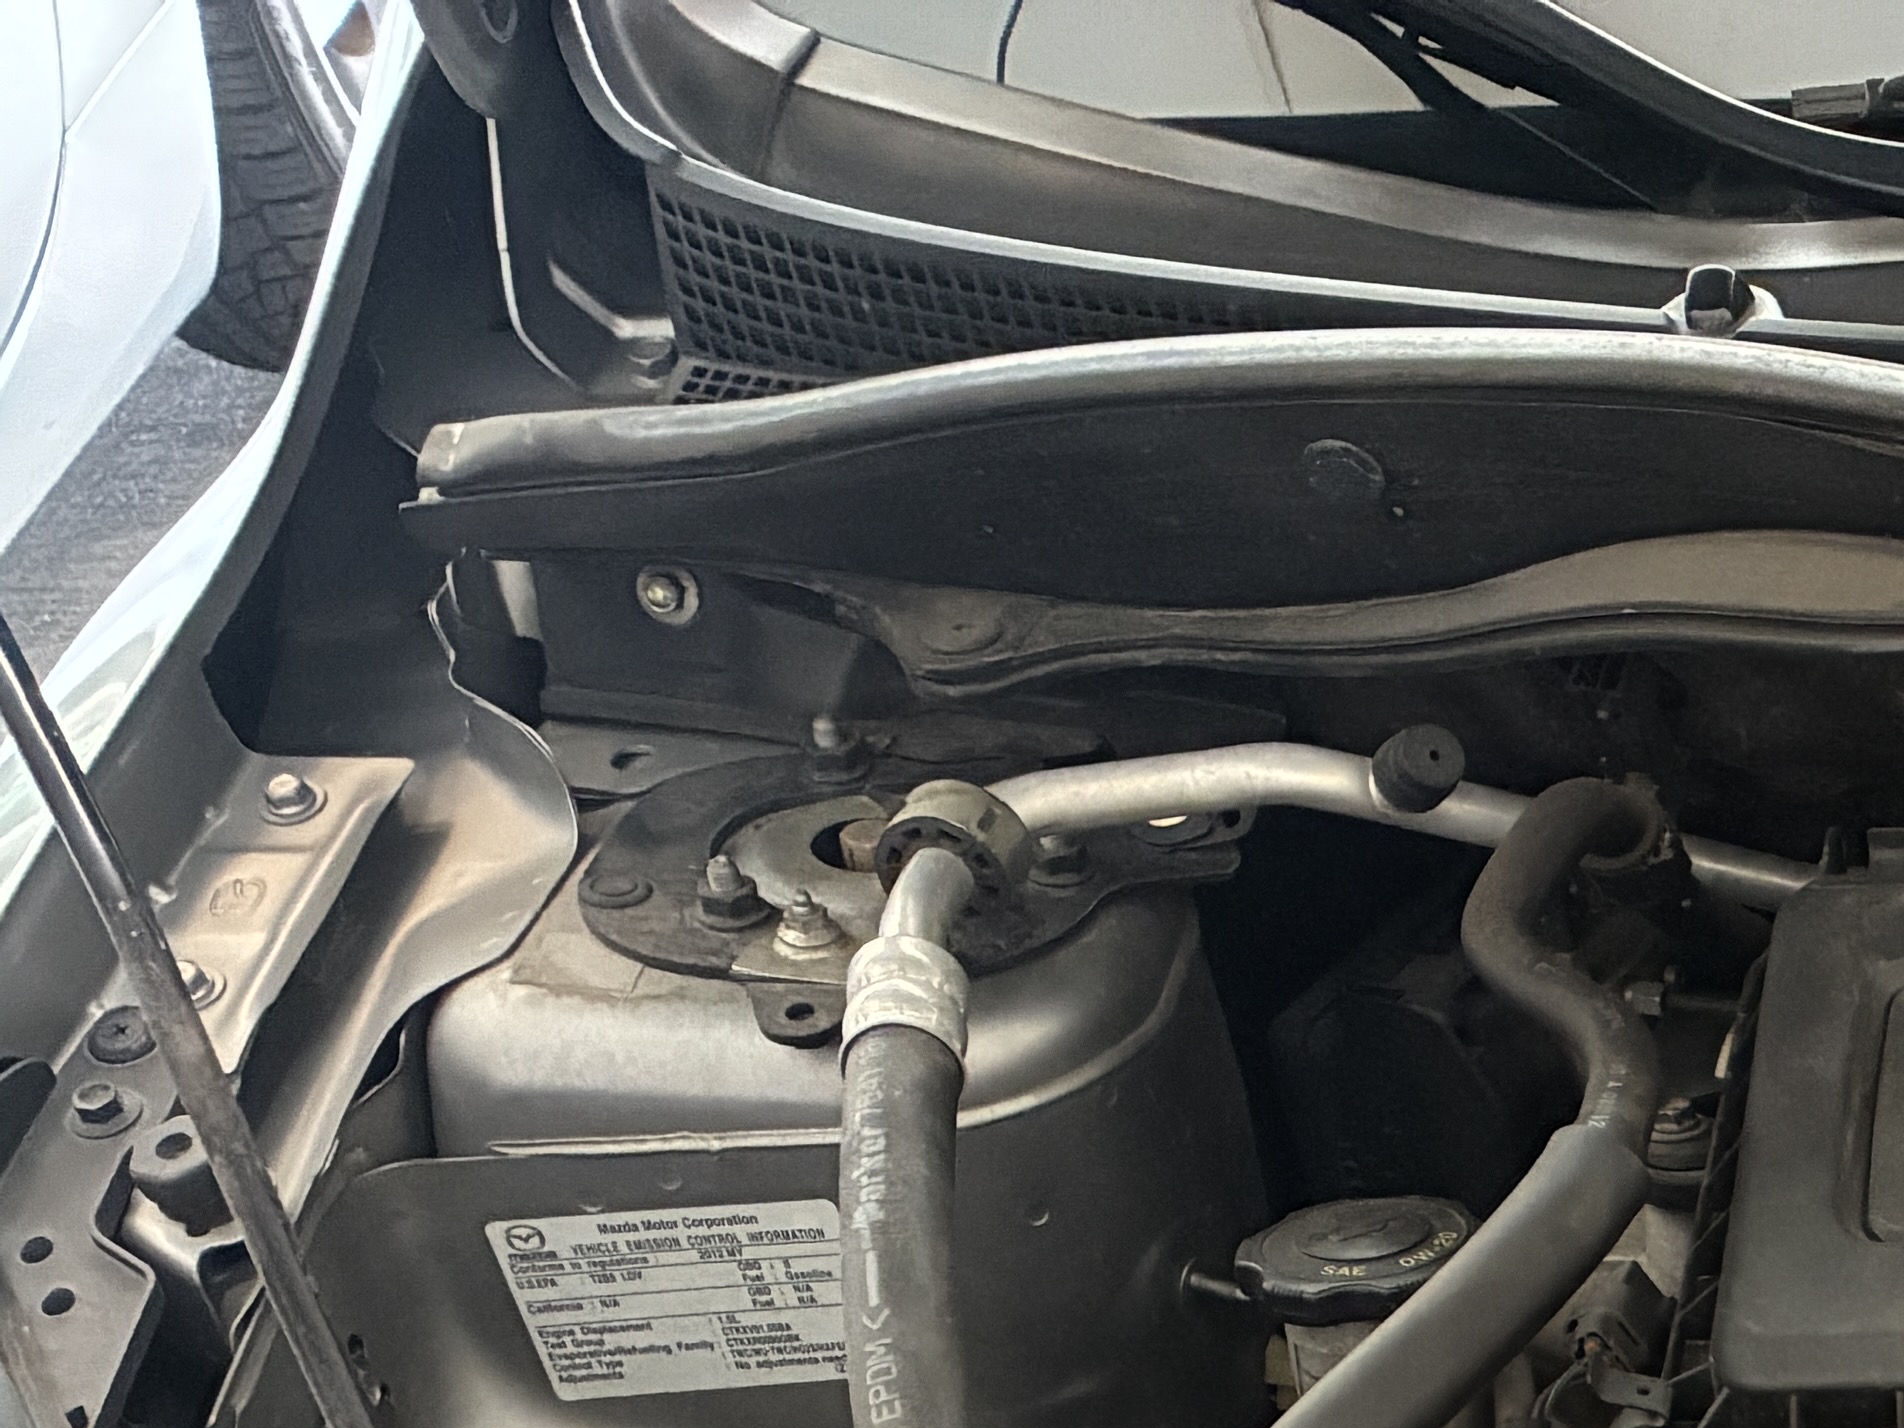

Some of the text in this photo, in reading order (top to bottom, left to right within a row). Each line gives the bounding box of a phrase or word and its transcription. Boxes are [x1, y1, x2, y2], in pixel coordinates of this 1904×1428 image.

[597, 1214, 760, 1235] Mazda Motor Corporation
[570, 1228, 826, 1256] VEHICLE EMISSION CONTROL INFORMATION
[1320, 1231, 1458, 1277] SAE 0W-20
[741, 1268, 834, 1284] Fuel Gasoline
[751, 1298, 776, 1309] Fuel
[864, 1337, 902, 1425] EPDM
